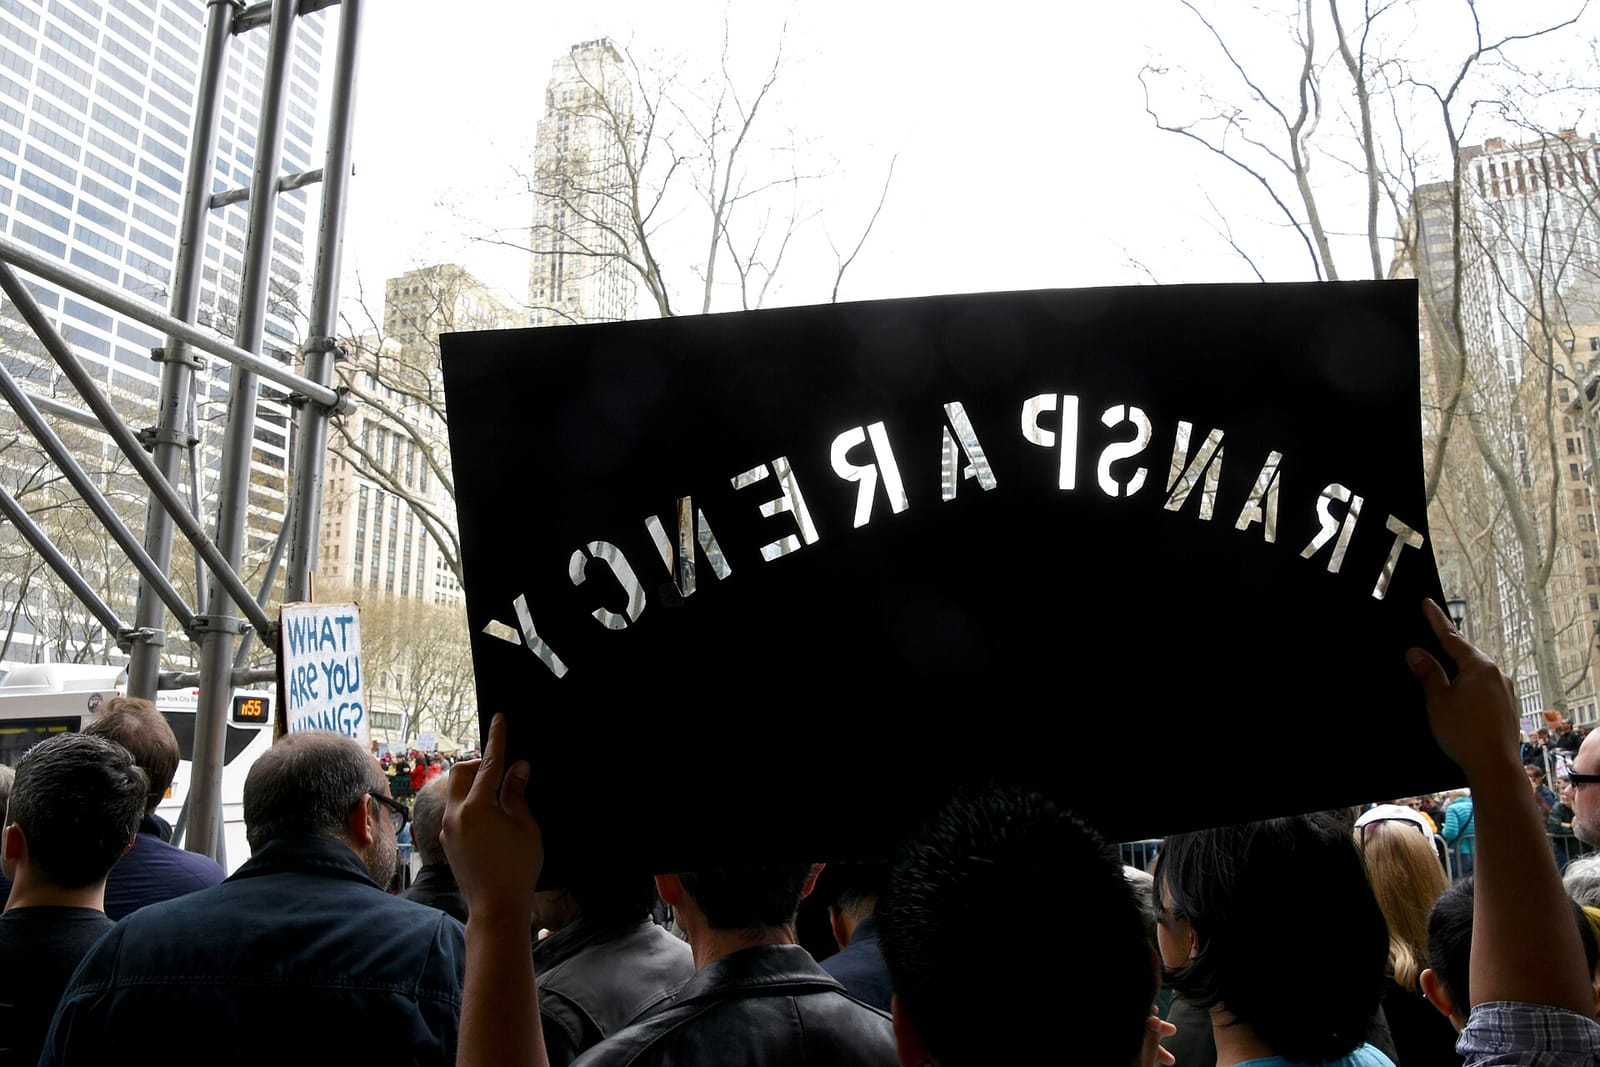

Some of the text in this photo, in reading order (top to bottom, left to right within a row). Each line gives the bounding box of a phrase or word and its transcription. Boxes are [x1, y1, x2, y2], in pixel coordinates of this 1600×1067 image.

[287, 615, 353, 656] WHAT
[321, 656, 359, 700] YOU
[179, 695, 190, 703] City
